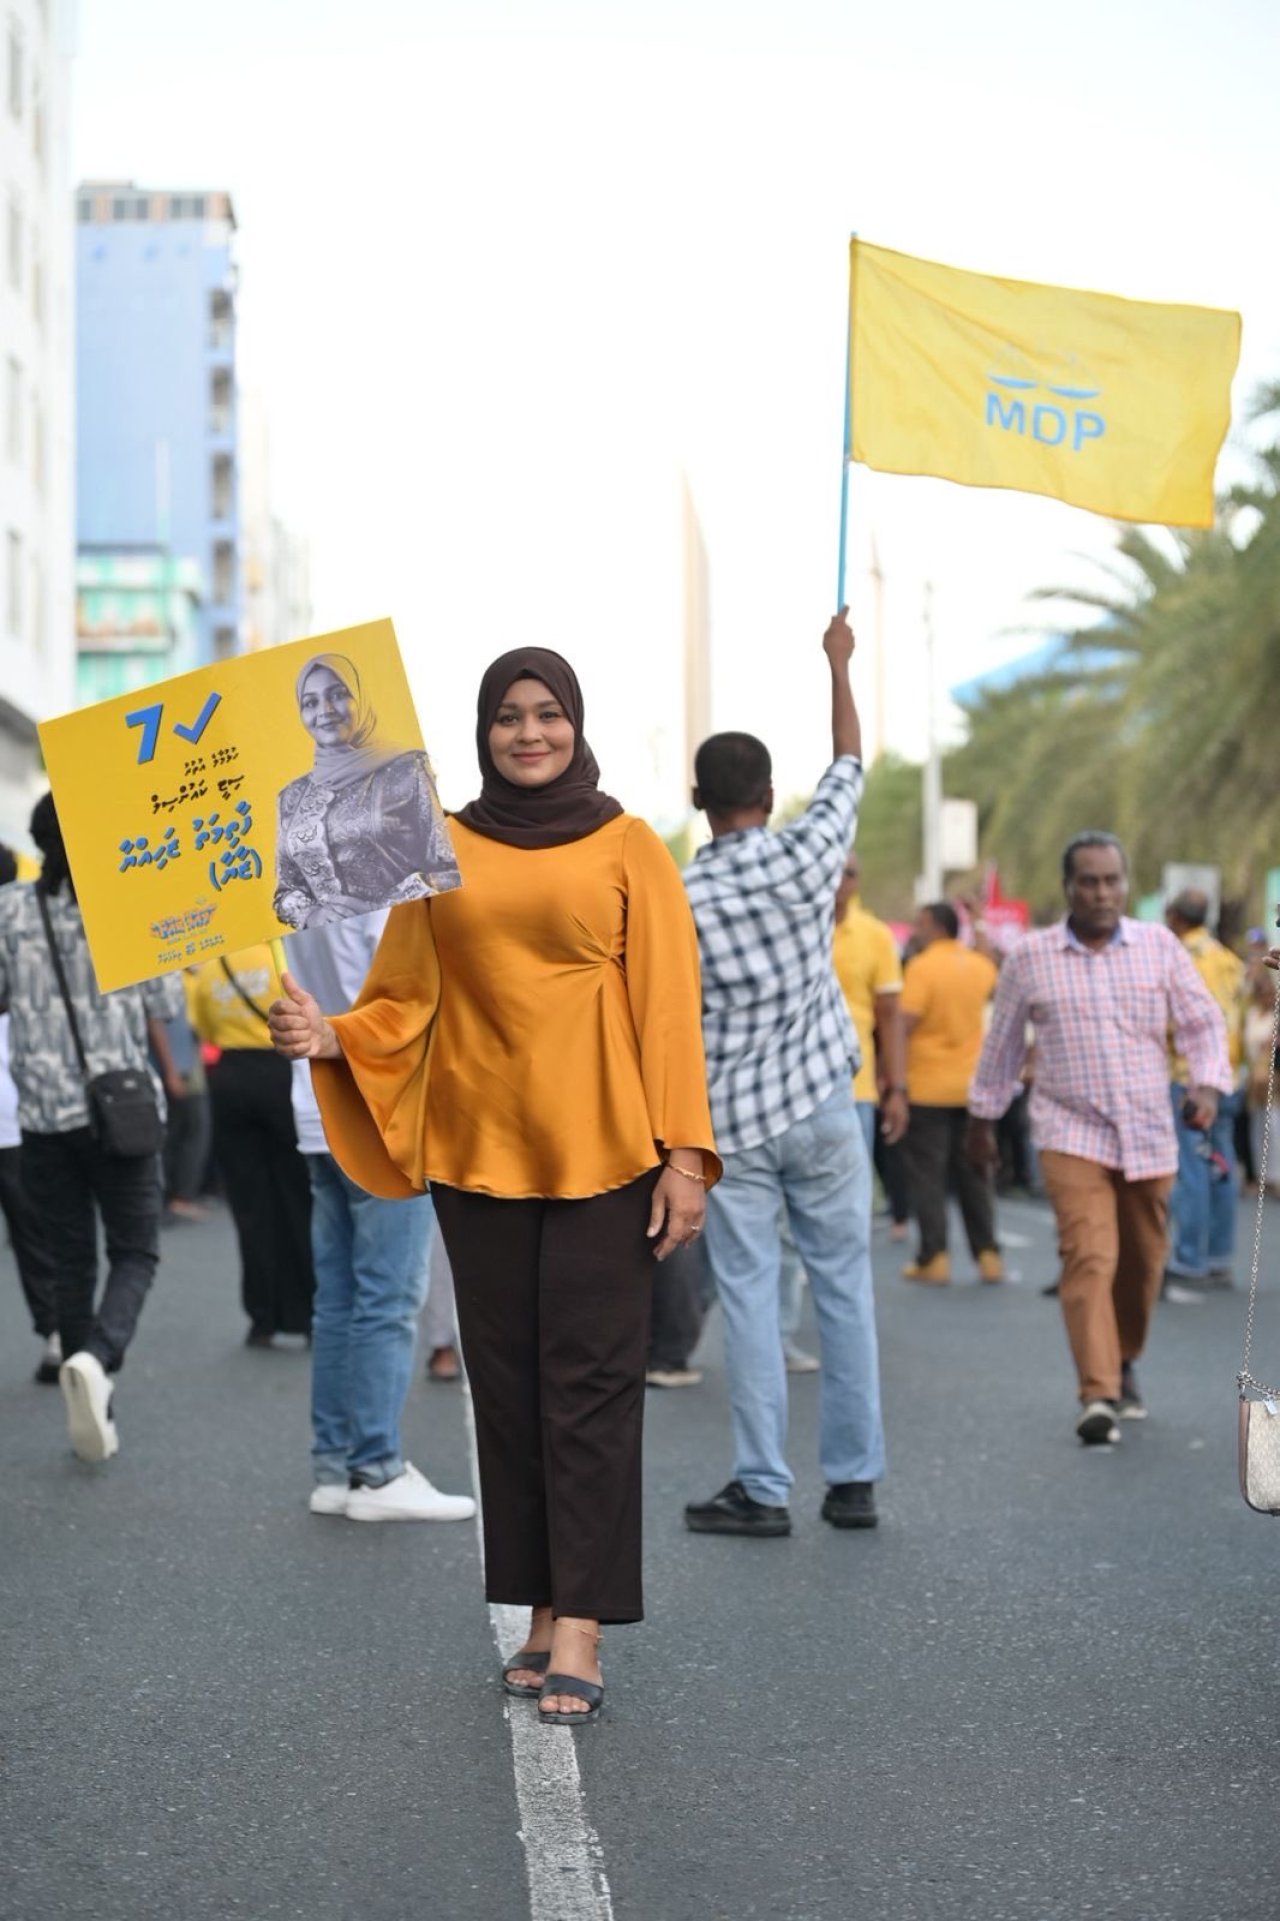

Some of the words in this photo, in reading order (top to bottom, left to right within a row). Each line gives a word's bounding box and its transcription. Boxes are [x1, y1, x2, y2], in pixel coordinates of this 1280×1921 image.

[986, 391, 1106, 452] MDP
[125, 703, 163, 765] 7
[151, 779, 208, 814] ކައުންސިލް
[217, 775, 245, 800] ސިޓީ
[192, 800, 253, 850] ފާތިމަތު
